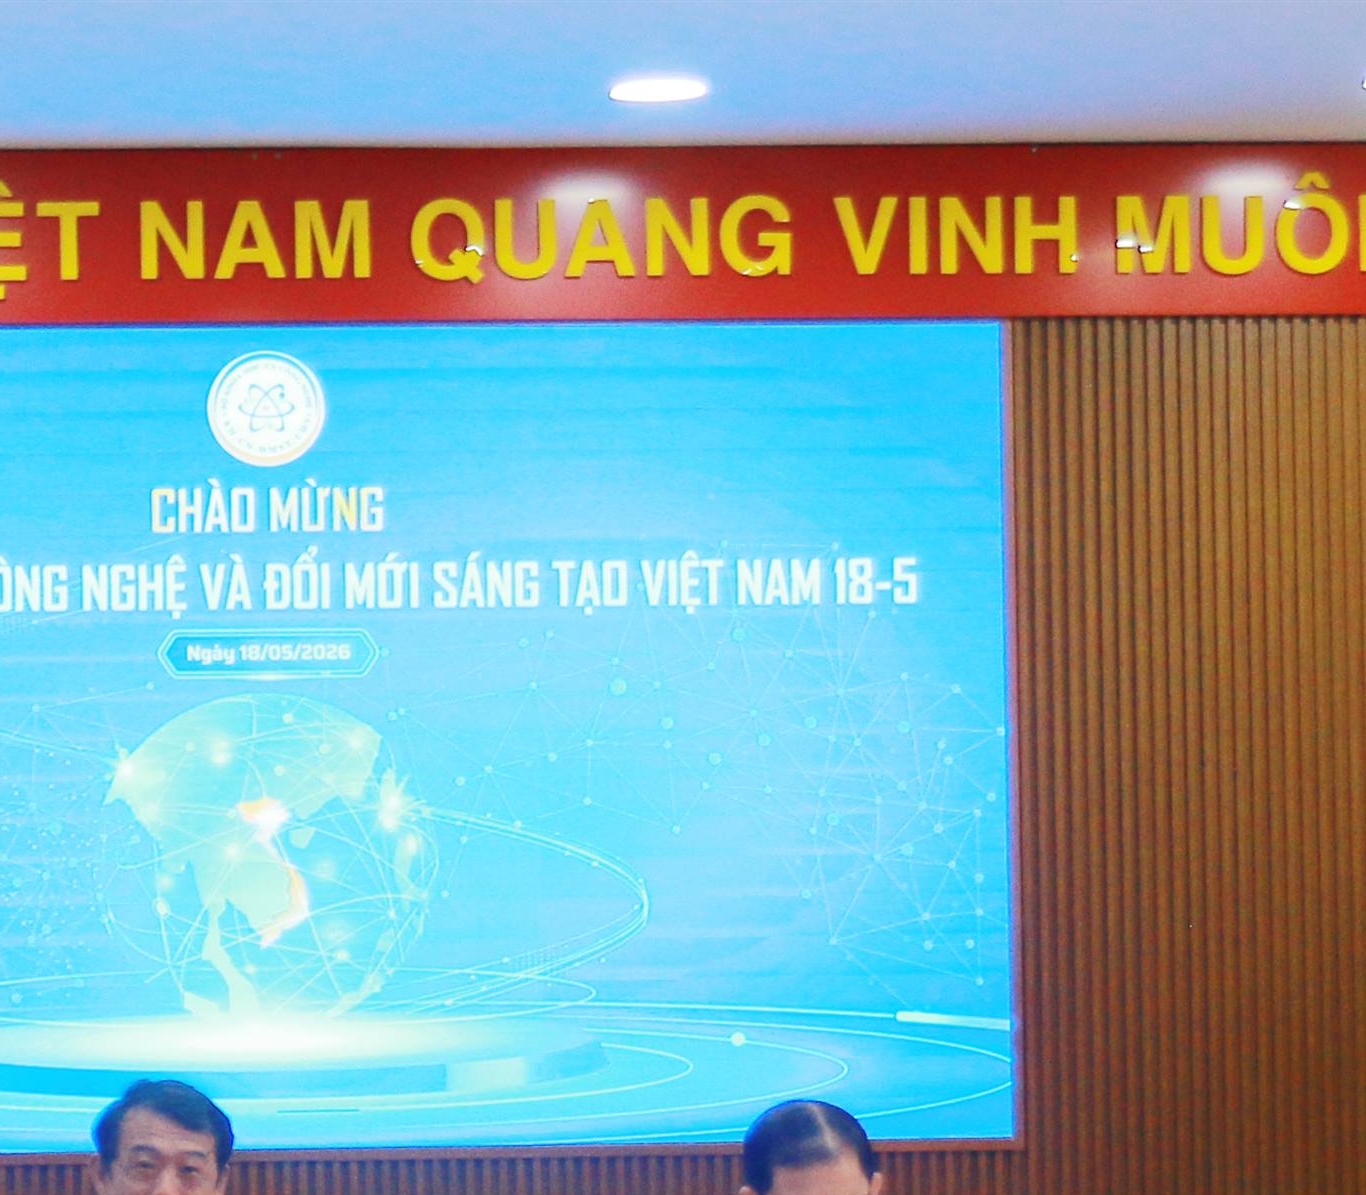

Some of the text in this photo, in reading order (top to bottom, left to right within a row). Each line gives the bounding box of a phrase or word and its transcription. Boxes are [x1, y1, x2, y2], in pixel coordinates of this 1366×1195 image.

[141, 199, 370, 279] NAM
[411, 194, 792, 282] QUANG
[835, 196, 1078, 274] VINH
[151, 478, 384, 533] CHÀO MỪNG
[82, 554, 187, 619] NGHỆ
[199, 553, 252, 610] VÀ
[263, 545, 331, 609] ĐỔI
[345, 552, 419, 608] MỚI
[434, 551, 539, 608] SÁNG
[552, 559, 627, 614] TẠO
[640, 550, 724, 613] VIỆT
[737, 558, 822, 605] NAM
[835, 557, 918, 604] 18-5
[186, 644, 234, 664] Ngày
